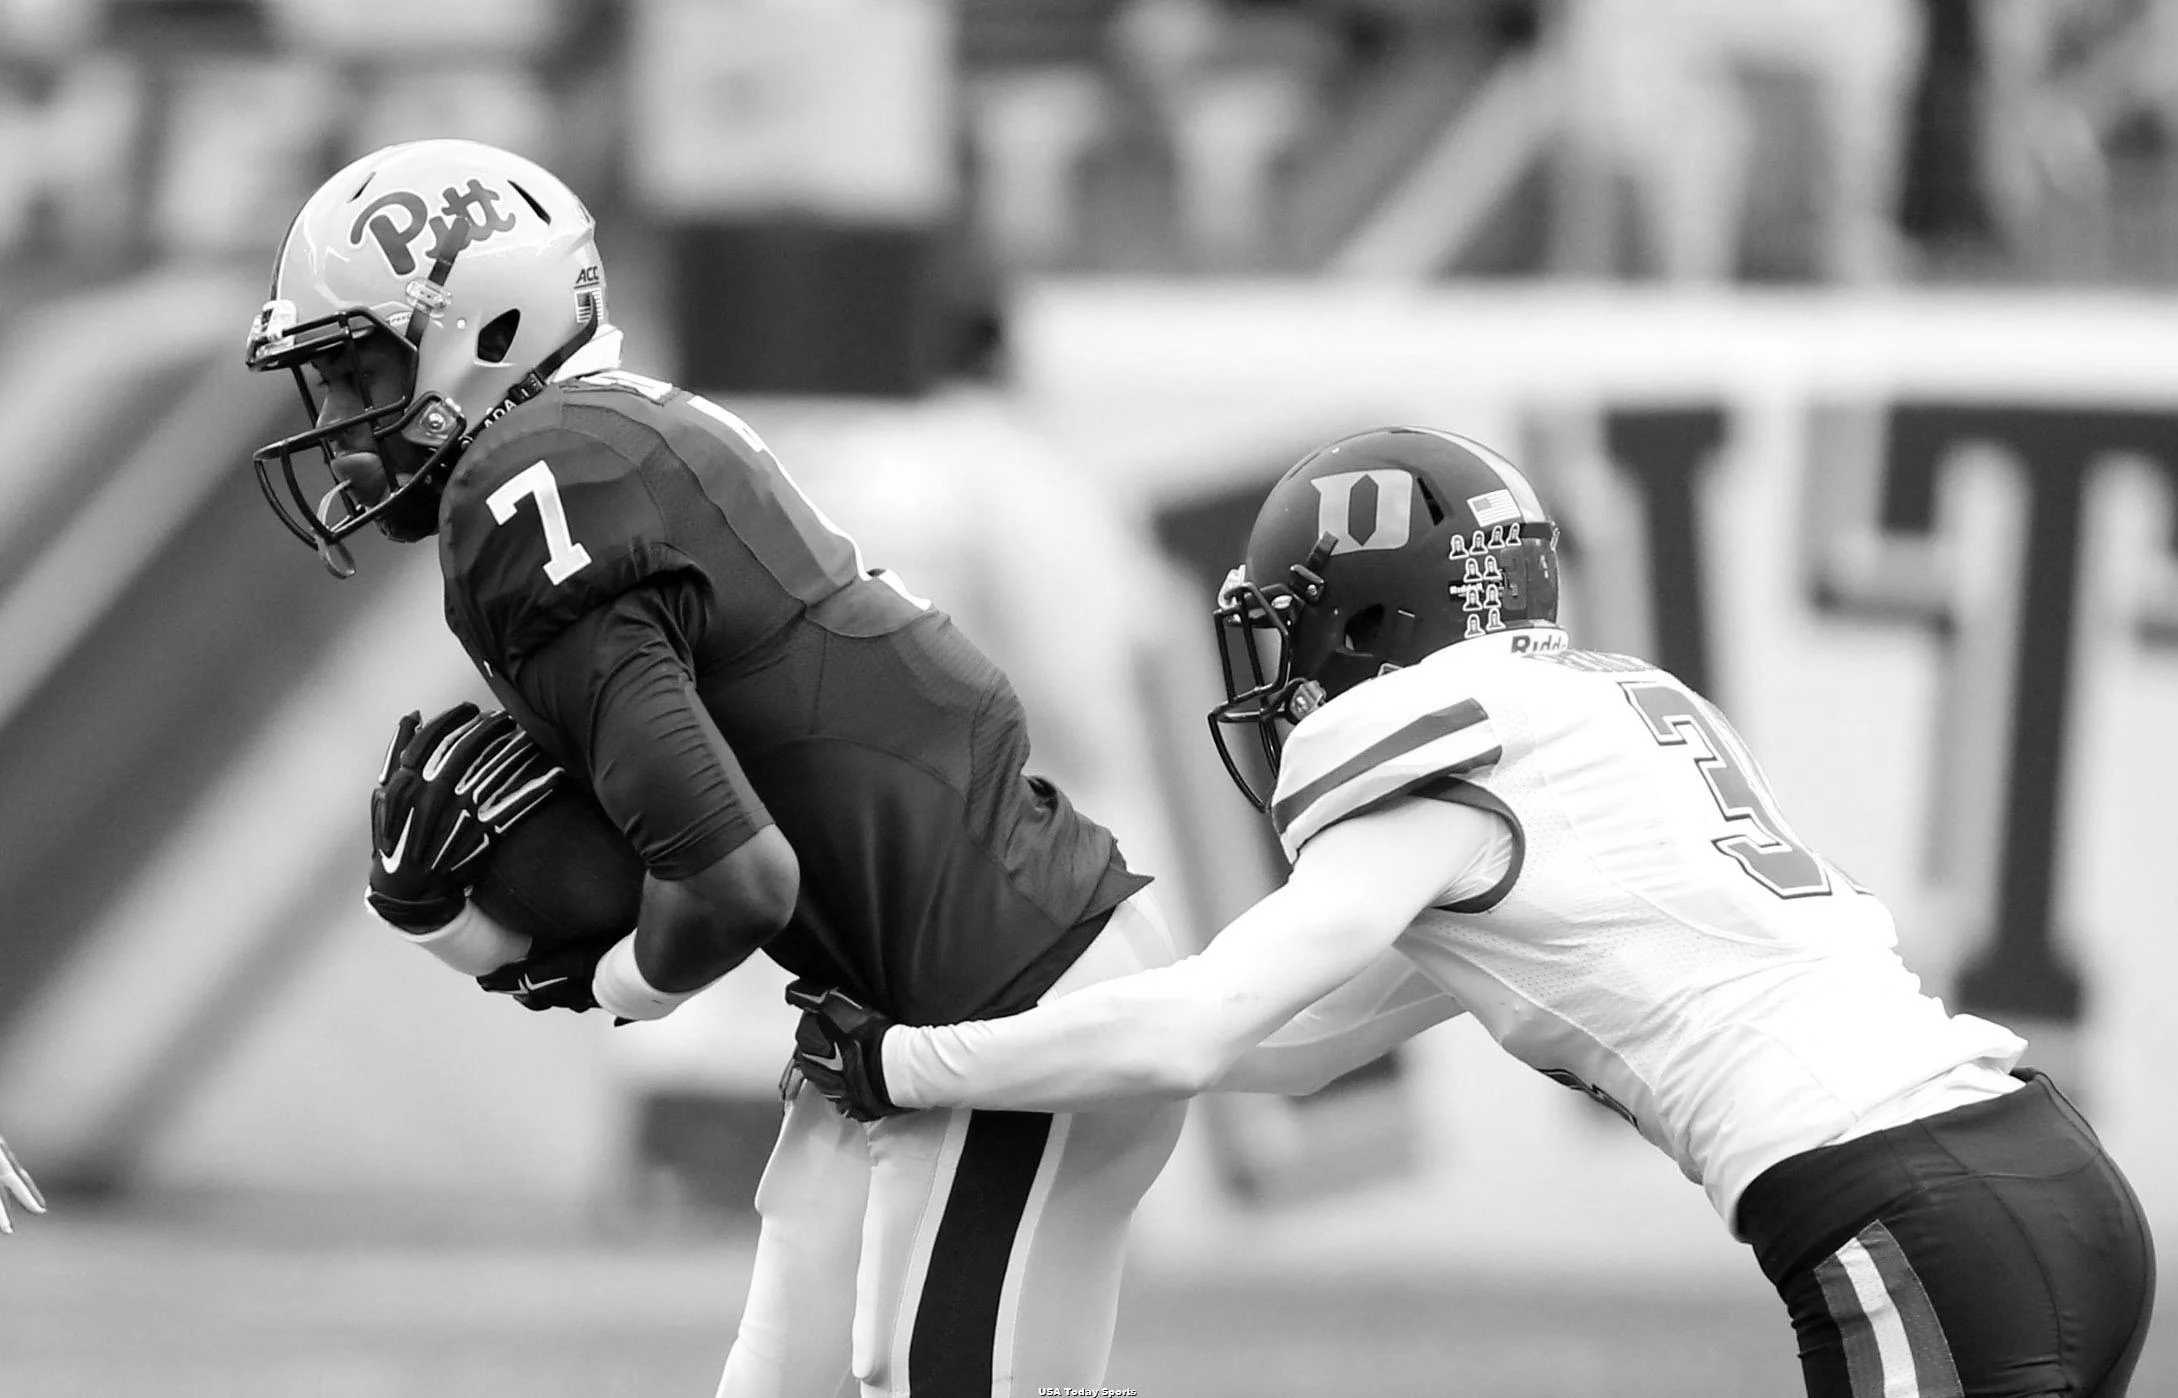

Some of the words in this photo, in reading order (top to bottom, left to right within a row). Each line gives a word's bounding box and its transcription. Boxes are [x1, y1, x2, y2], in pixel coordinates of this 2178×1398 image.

[350, 178, 516, 276] Pitt
[575, 266, 599, 284] ACC
[486, 460, 592, 586] 7
[1310, 468, 1413, 556] D
